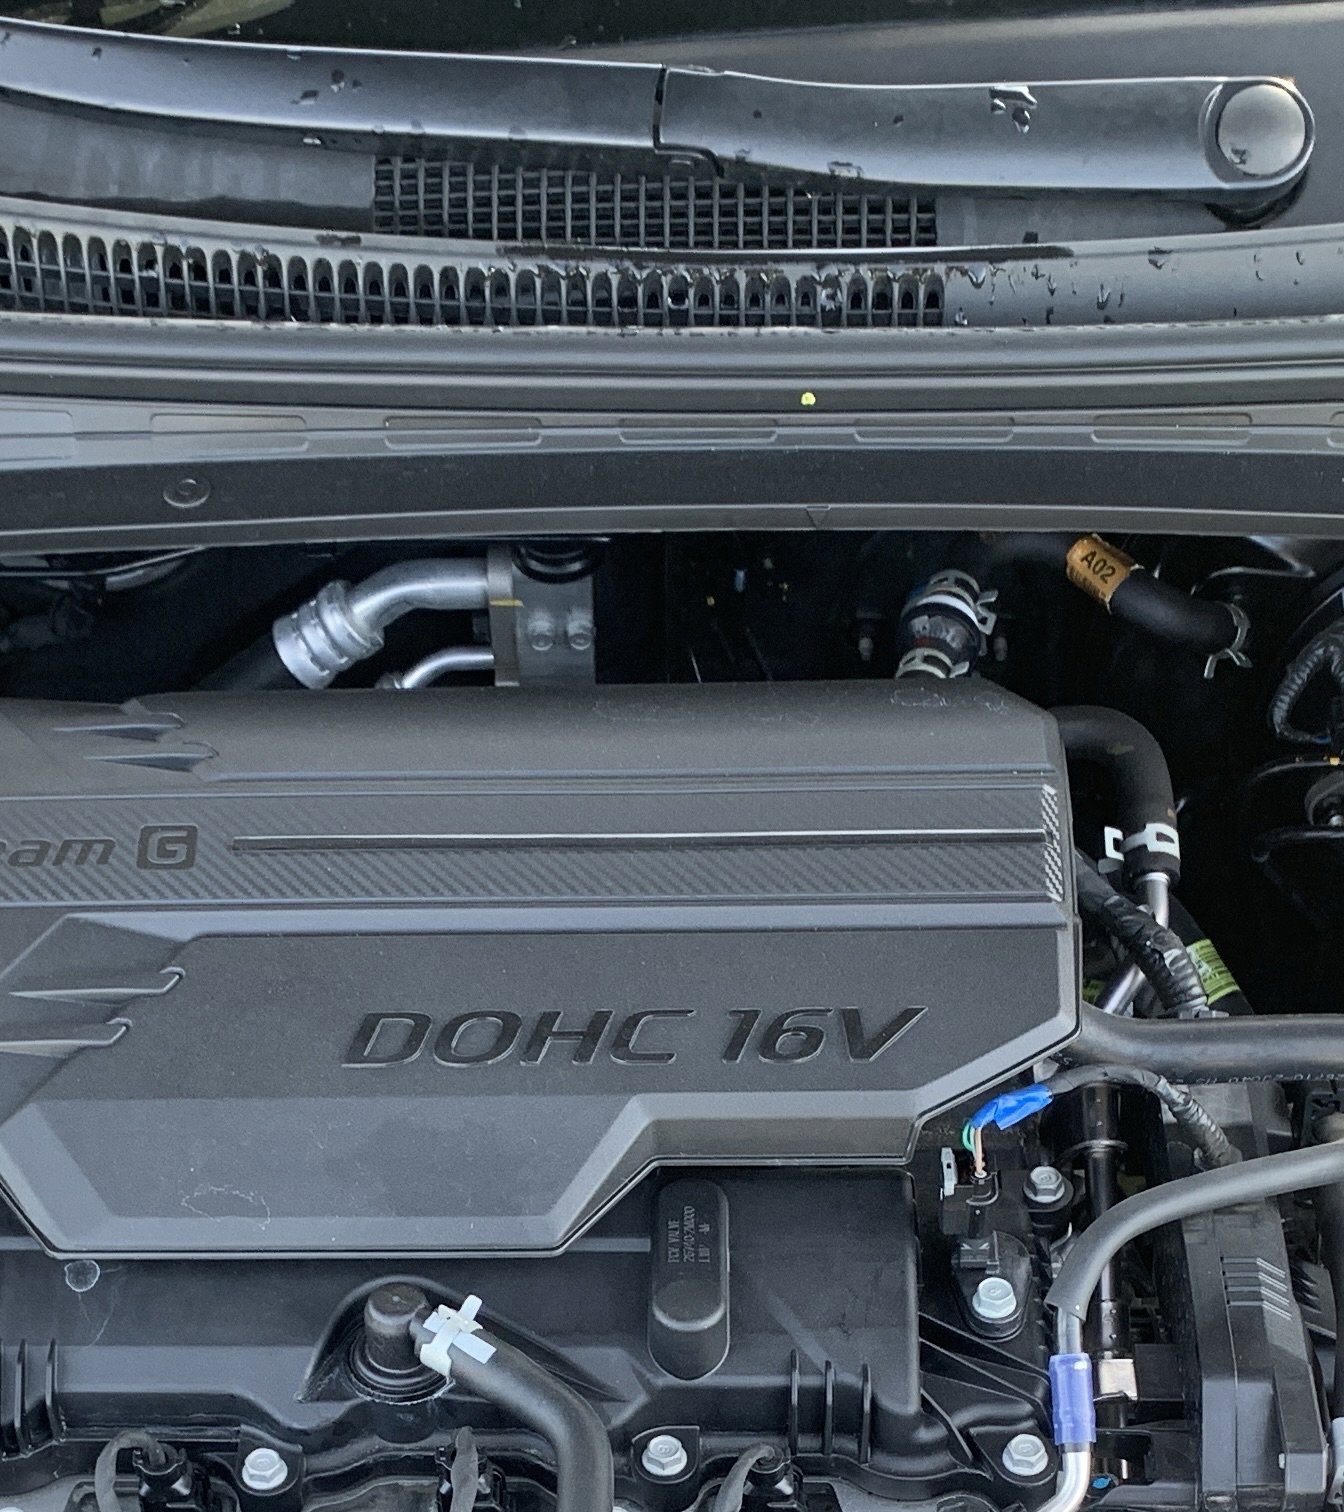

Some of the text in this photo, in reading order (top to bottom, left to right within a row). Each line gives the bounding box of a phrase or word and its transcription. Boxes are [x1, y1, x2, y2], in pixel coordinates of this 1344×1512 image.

[1080, 549, 1116, 585] A02
[142, 829, 193, 867] G
[342, 1004, 928, 1066] DOHC 16V
